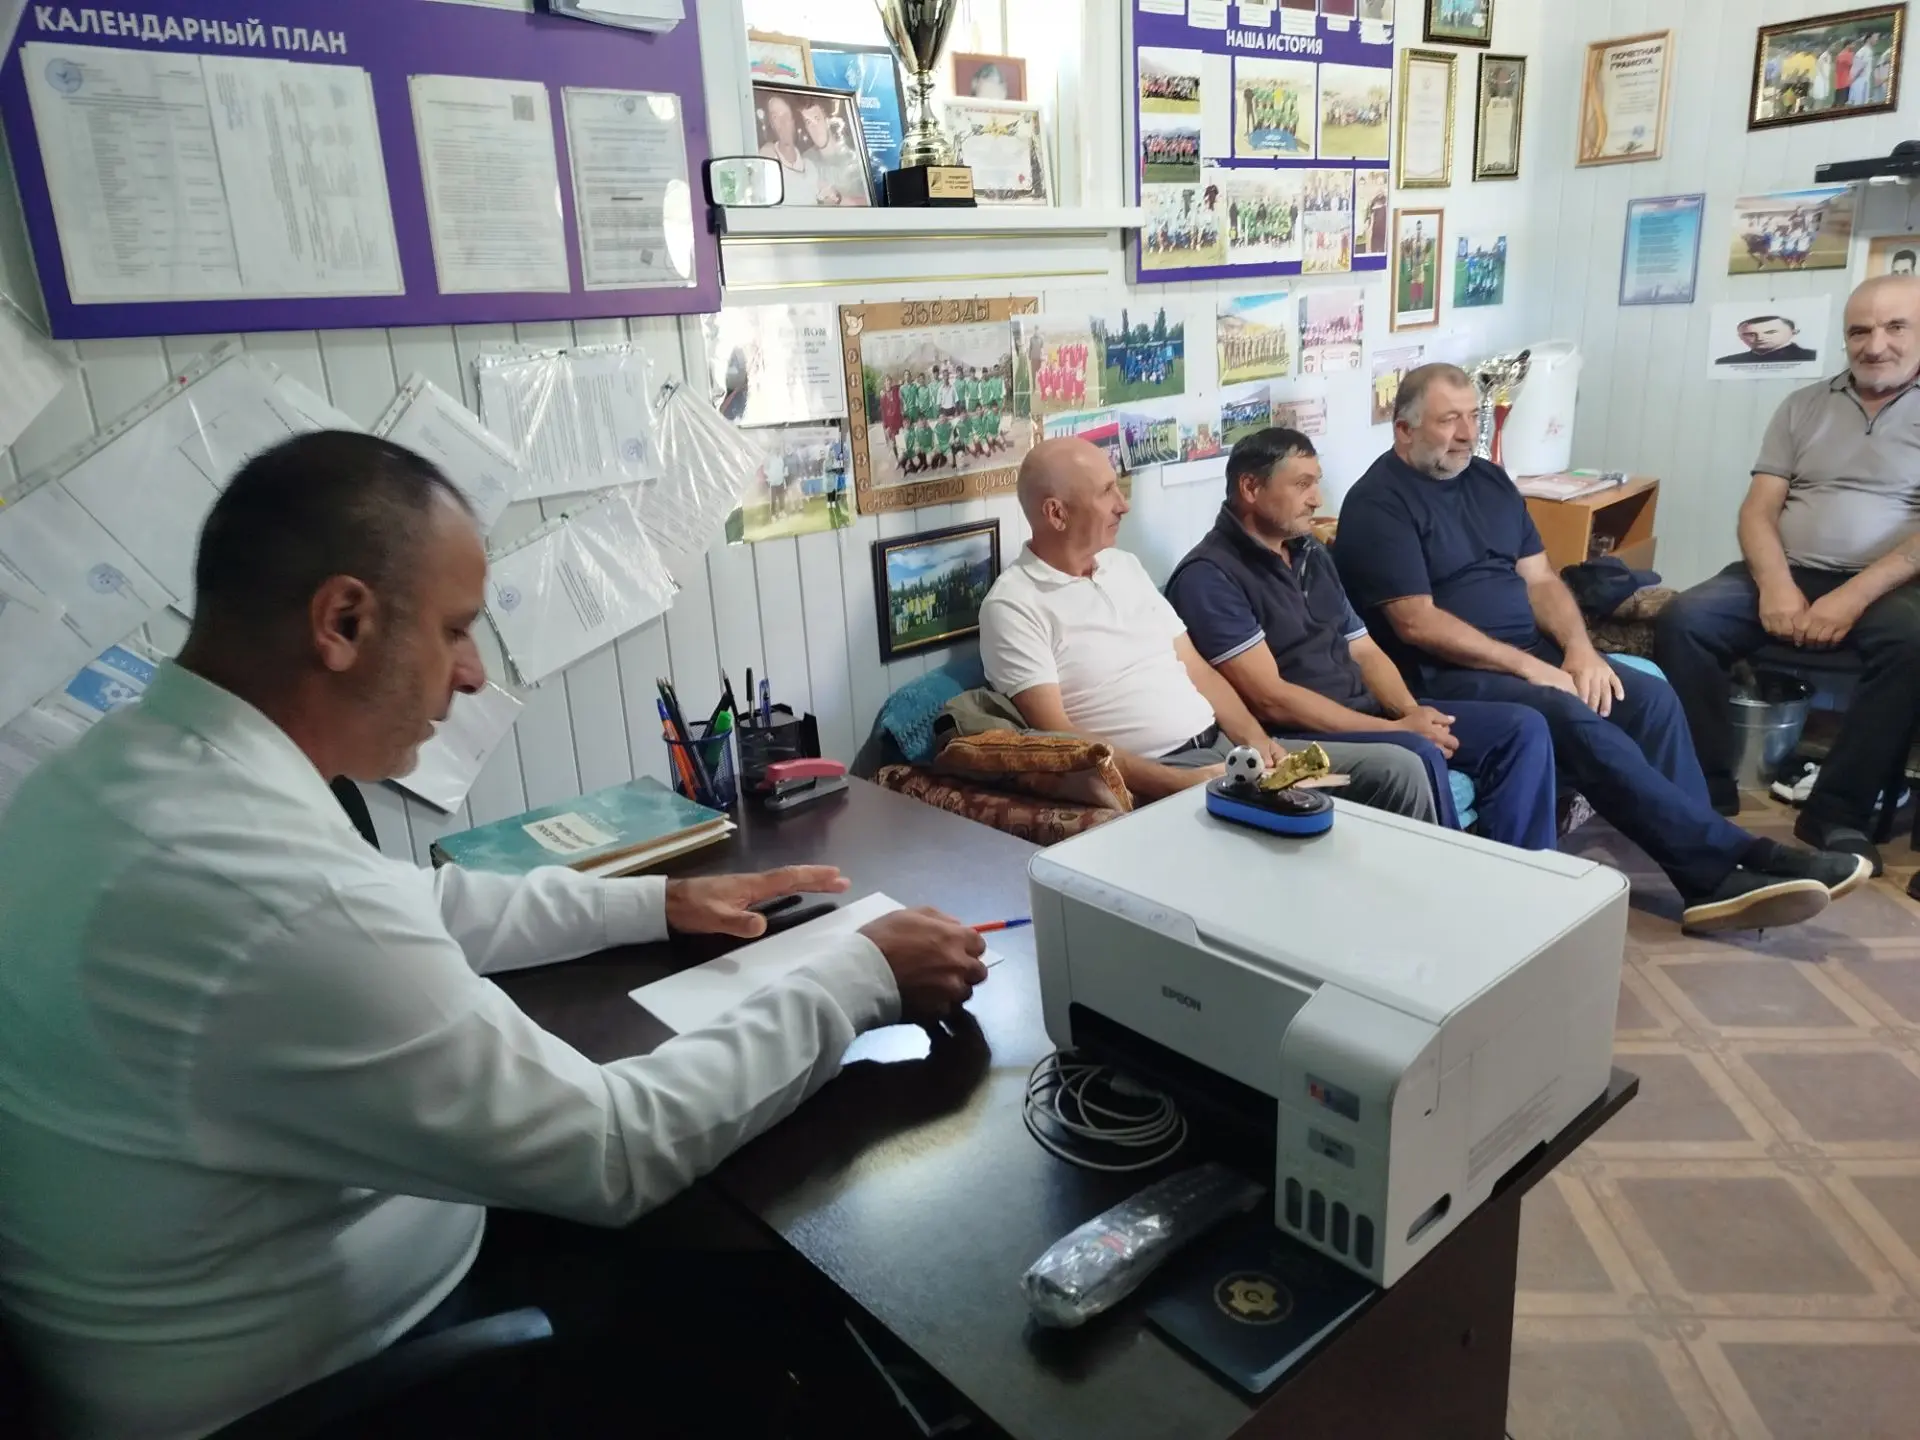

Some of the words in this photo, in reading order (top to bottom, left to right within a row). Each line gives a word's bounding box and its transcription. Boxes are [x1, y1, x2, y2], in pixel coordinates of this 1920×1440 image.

[34, 6, 267, 47] КАЛЕНДАРНЫЙ
[271, 25, 347, 54] ПЛАН
[1226, 29, 1265, 49] НАША
[1266, 33, 1323, 55] ИСТОРИЯ
[1161, 985, 1202, 1011] EPSON
